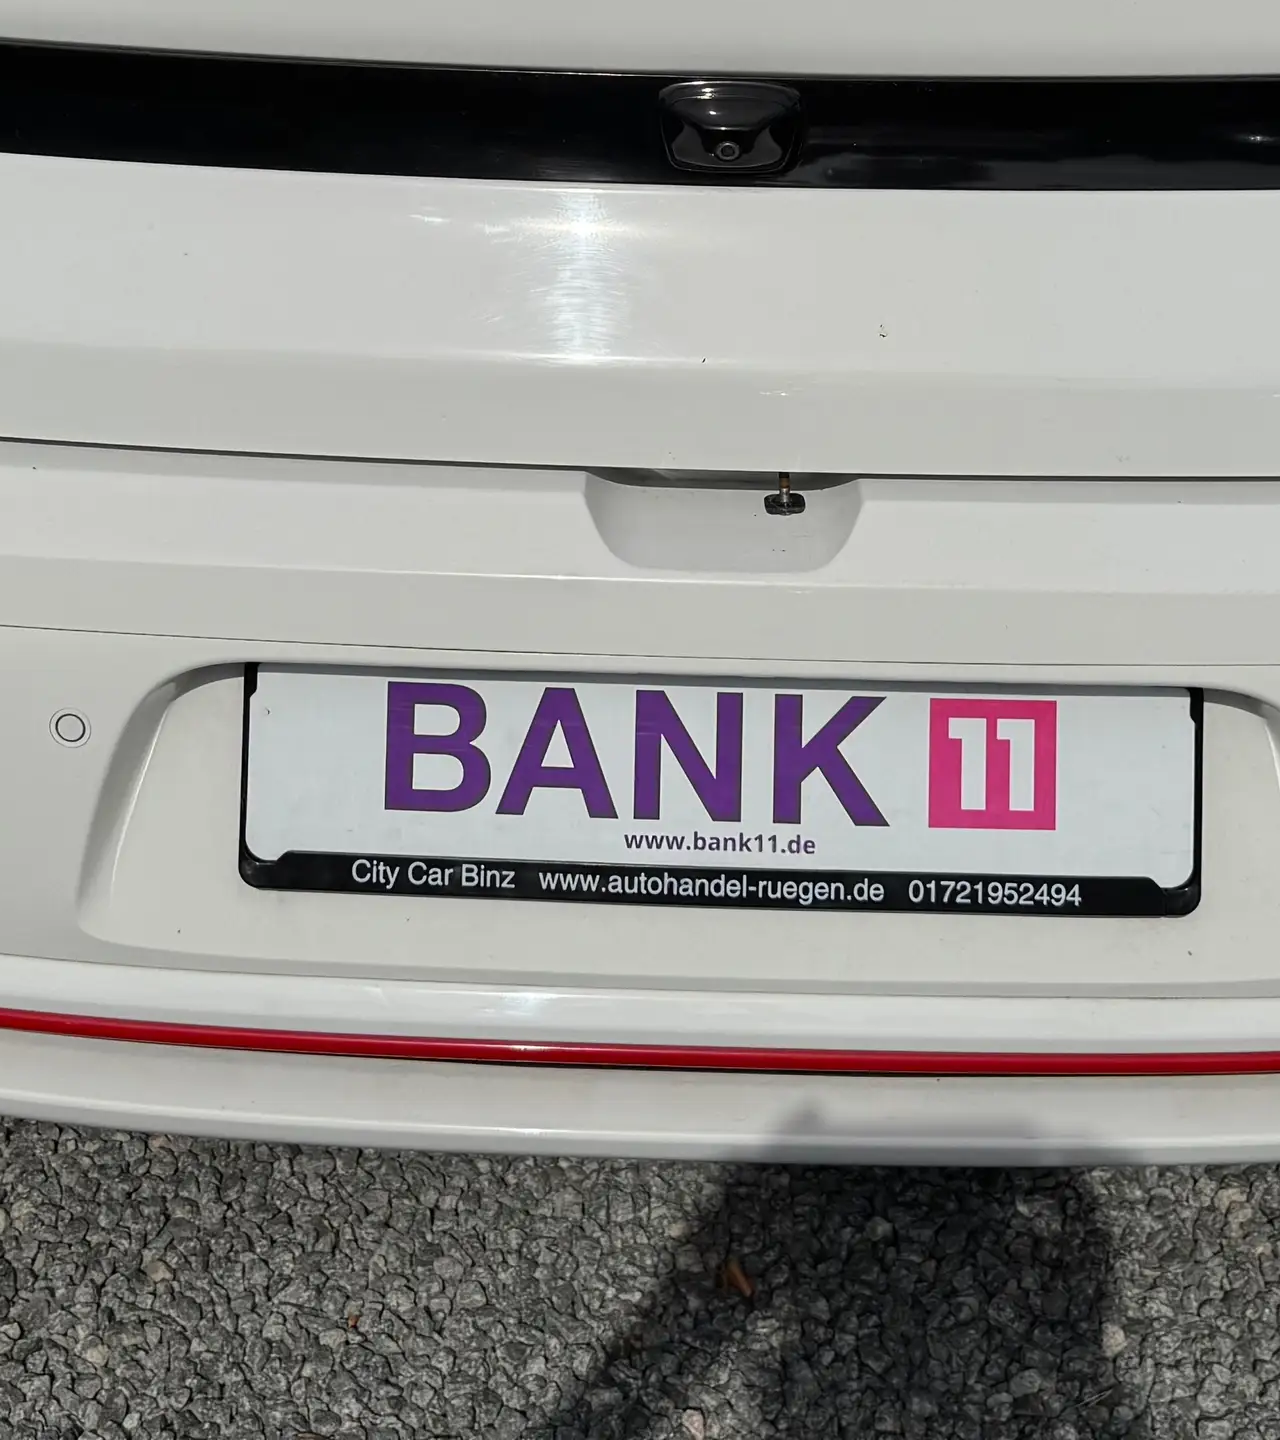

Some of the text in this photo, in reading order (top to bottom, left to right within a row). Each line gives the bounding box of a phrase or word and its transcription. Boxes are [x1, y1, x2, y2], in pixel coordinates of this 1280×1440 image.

[384, 681, 1035, 827] BANK 11
[624, 831, 816, 855] www.bank11.de
[351, 858, 1082, 907] City Car Binz www.autohandel-ruegen.de 01721952494
